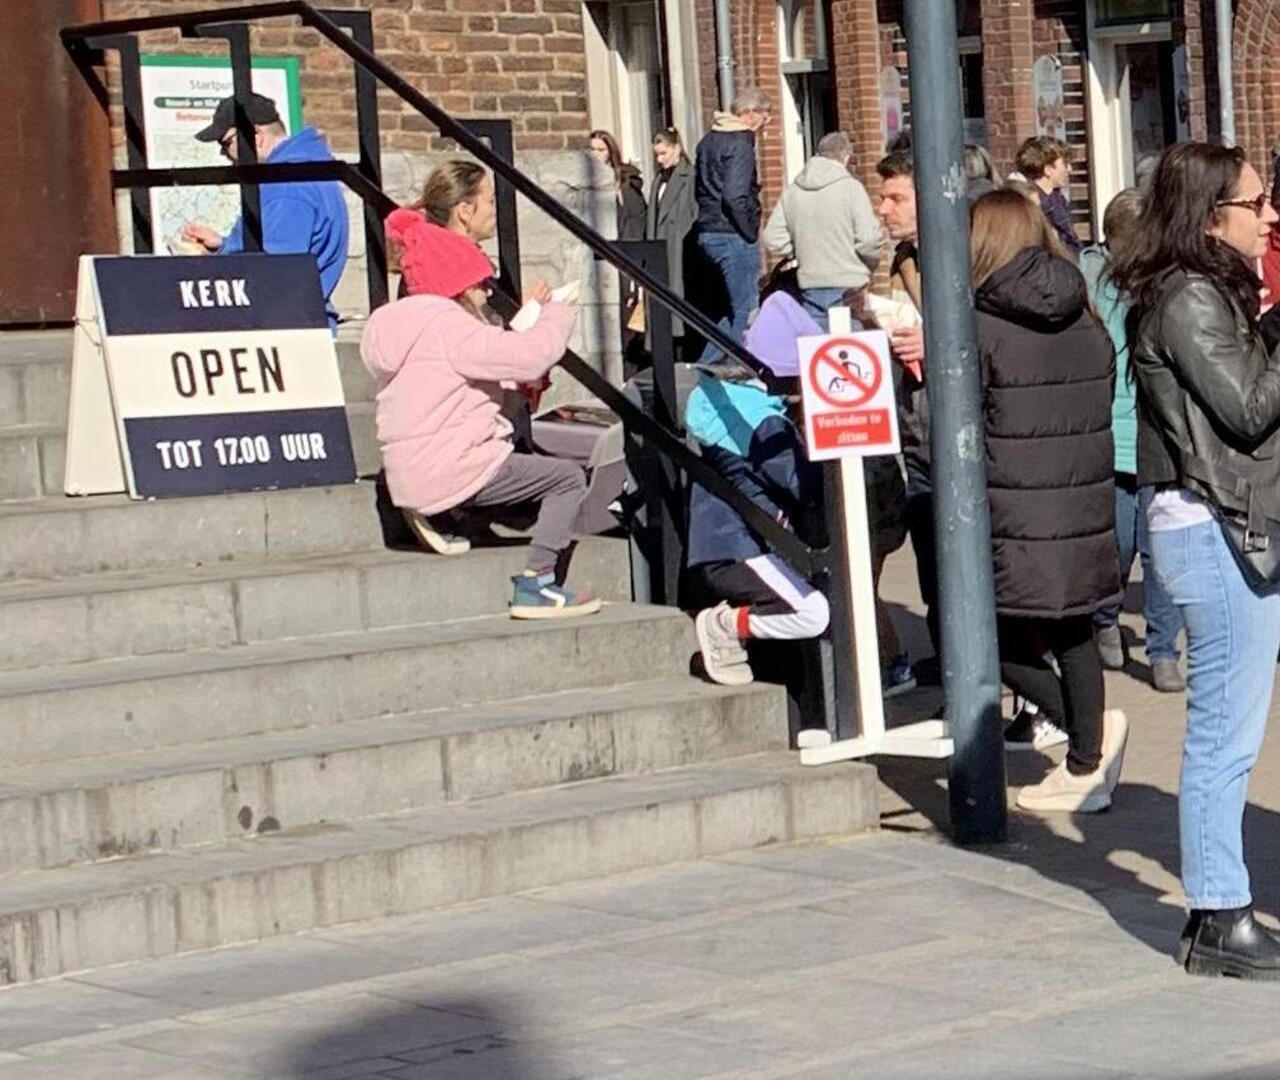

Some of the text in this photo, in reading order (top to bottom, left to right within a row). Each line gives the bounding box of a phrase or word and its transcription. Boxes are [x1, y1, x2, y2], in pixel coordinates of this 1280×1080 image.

[179, 279, 251, 309] KERK
[170, 347, 286, 398] OPEN
[155, 433, 327, 470] TOT 17.00 UUR
